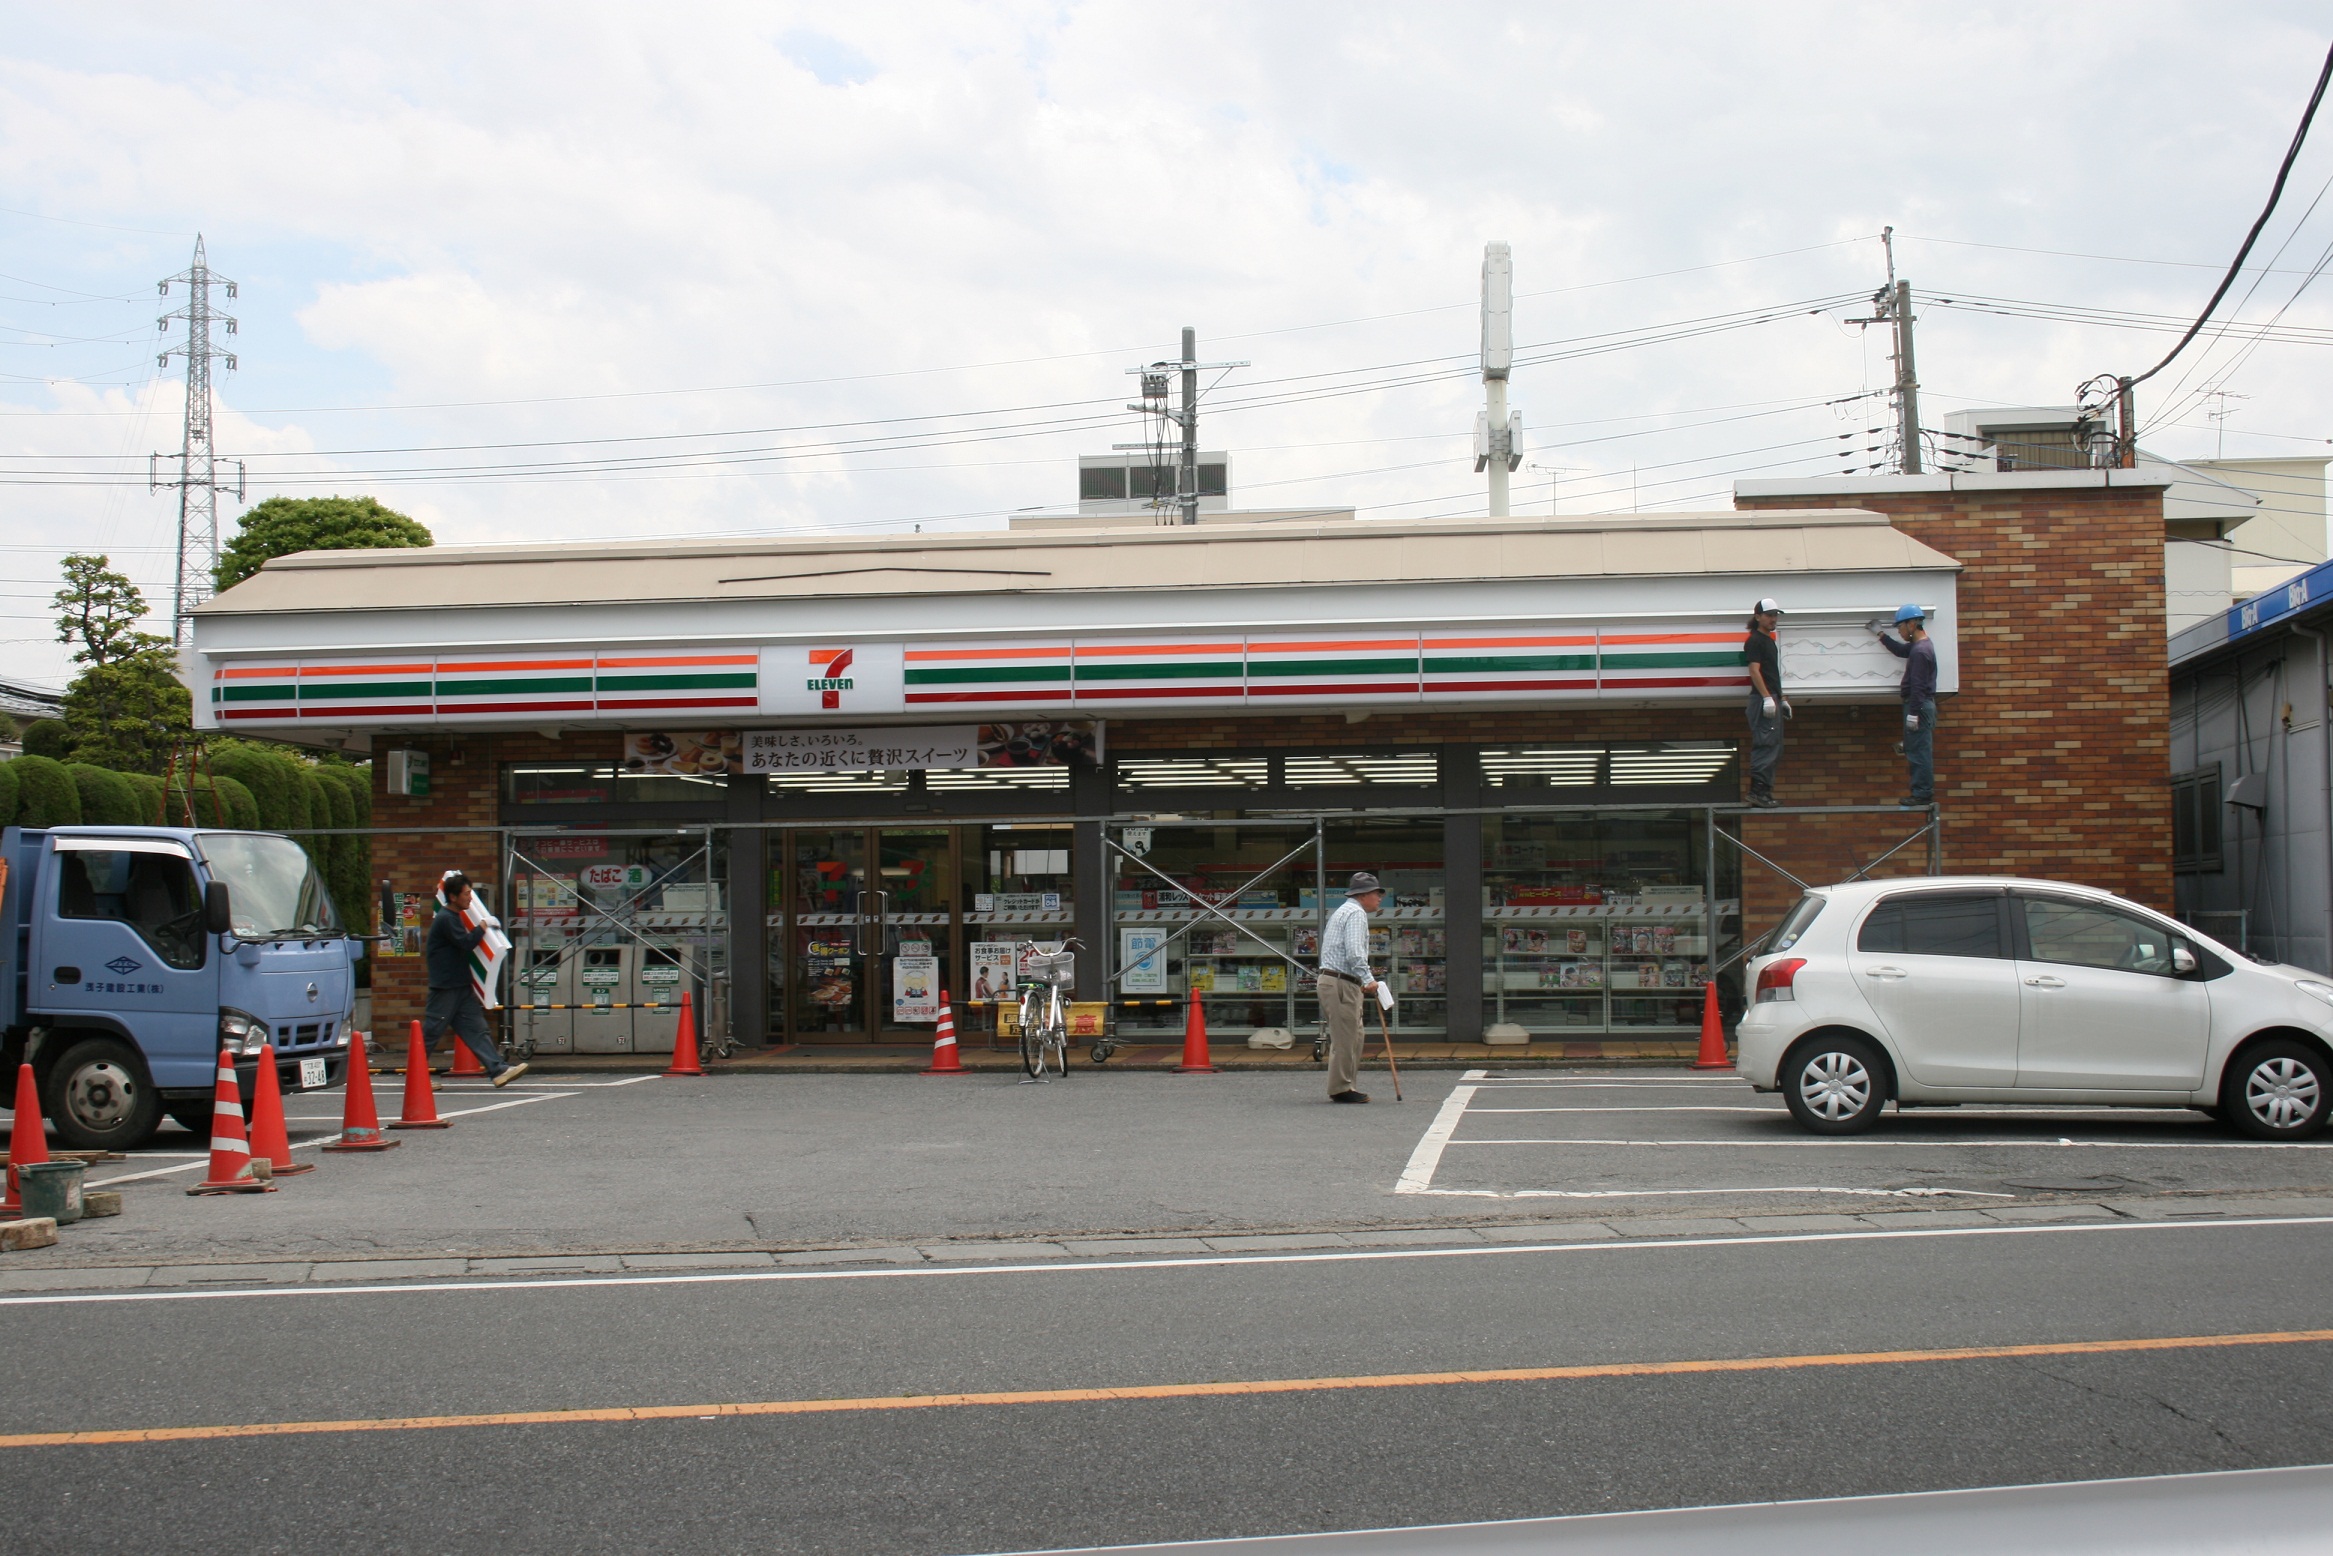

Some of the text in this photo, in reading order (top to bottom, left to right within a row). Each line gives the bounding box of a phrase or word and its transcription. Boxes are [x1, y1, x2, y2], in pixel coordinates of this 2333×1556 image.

[809, 649, 853, 709] 7
[751, 734, 863, 748] 美味しさ、いろいろ。
[751, 748, 968, 768] あなたの近くに贅沢スイーツ
[589, 869, 623, 883] たばこ
[628, 869, 643, 883] 酒
[1131, 937, 1156, 950] 節電
